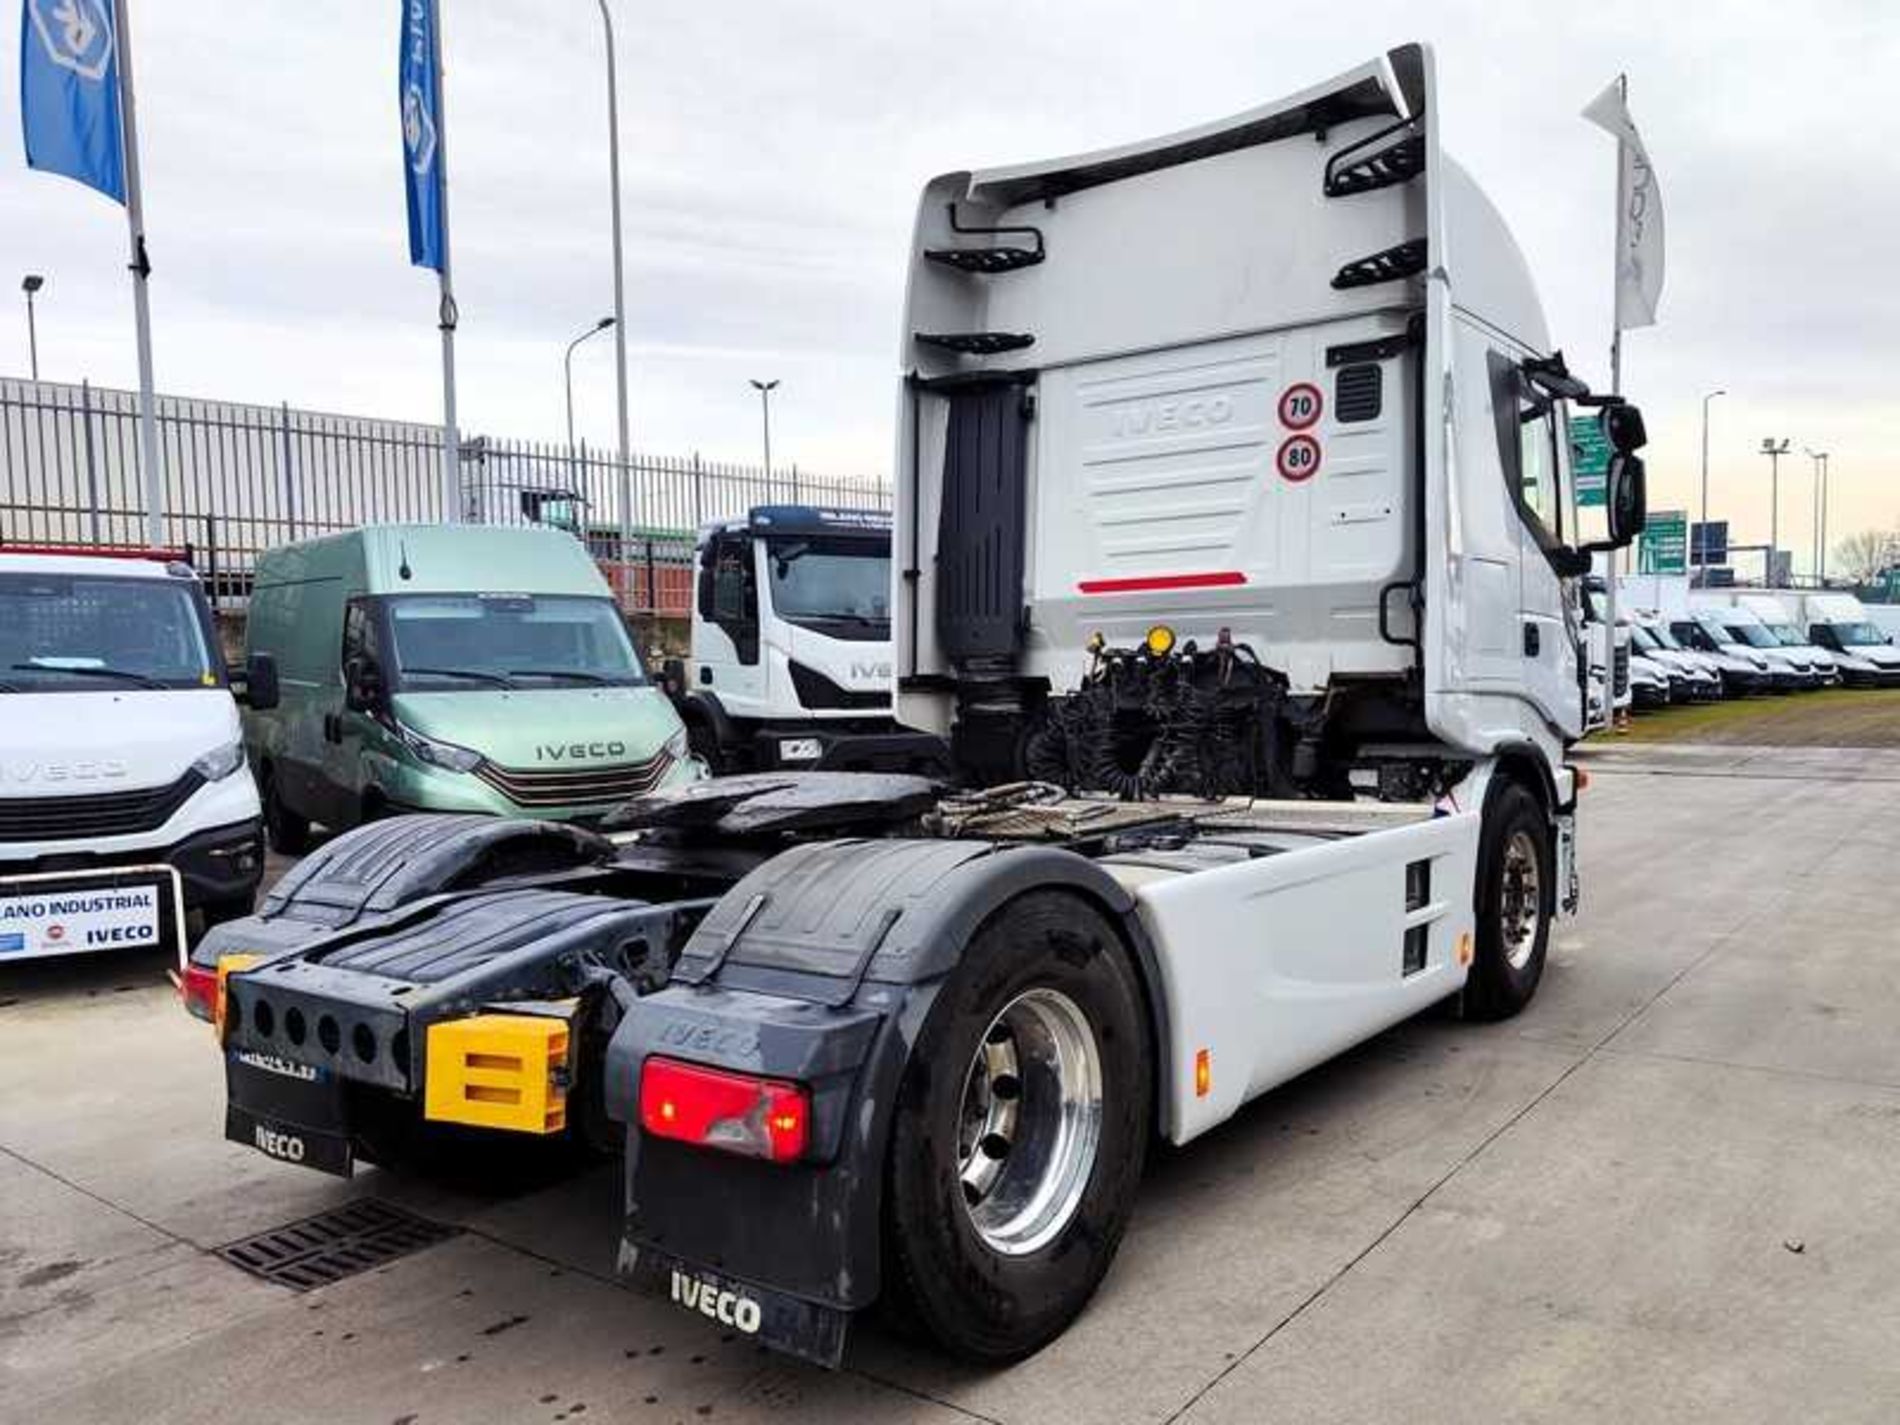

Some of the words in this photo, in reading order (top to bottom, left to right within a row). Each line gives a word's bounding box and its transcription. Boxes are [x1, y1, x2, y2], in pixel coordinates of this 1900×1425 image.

[1113, 396, 1233, 437] IVECO
[1290, 397, 1312, 417] 70
[1288, 447, 1312, 468] 80
[536, 741, 626, 761] IVECO
[0, 760, 127, 783] VECO
[0, 903, 46, 920] ANO
[50, 894, 152, 915] INDUSTRIAL
[86, 925, 153, 944] IVECO
[671, 1270, 761, 1334] IVECO
